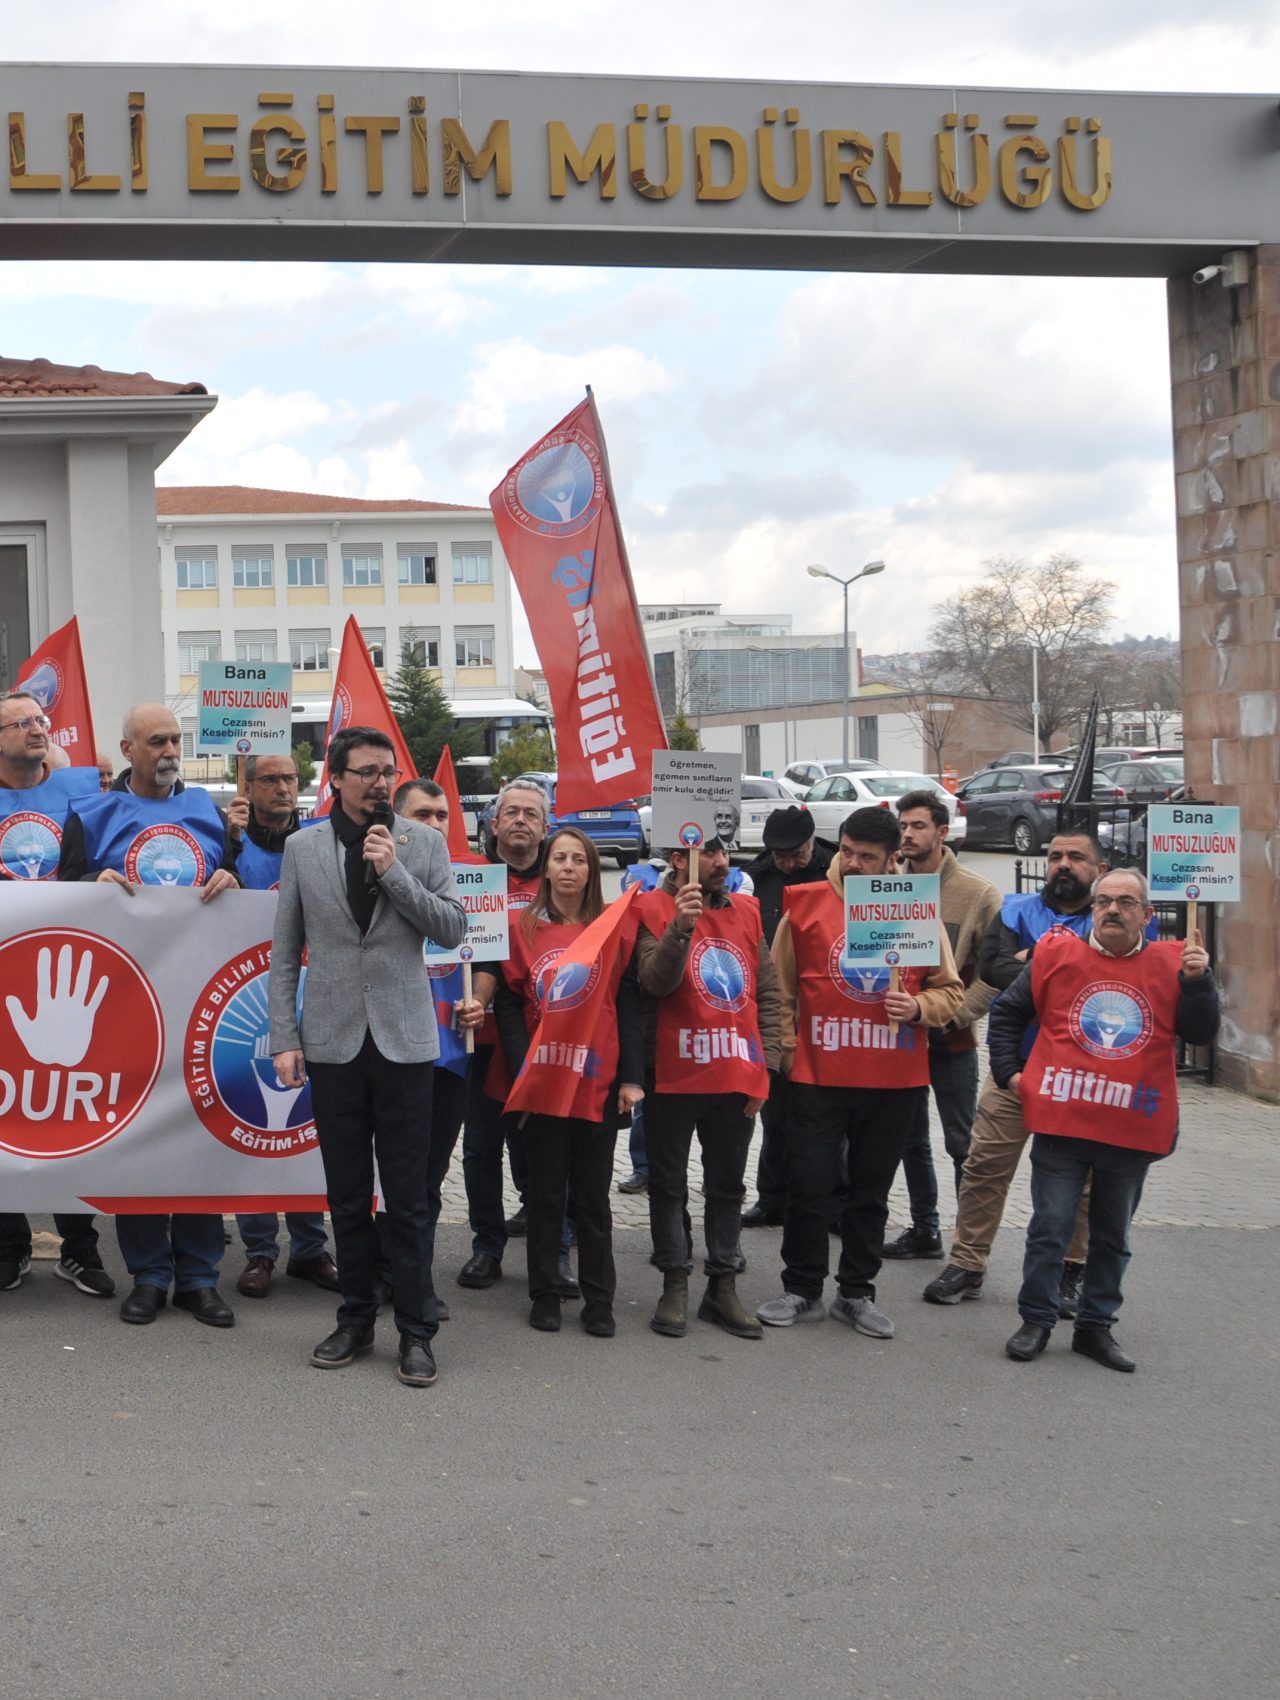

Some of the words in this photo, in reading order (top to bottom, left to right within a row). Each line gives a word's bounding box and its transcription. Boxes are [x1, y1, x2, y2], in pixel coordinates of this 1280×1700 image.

[187, 91, 512, 197] EĞİTİM
[546, 102, 1114, 211] MÜDÜRLÜĞÜ
[225, 665, 266, 680] Bana
[202, 688, 288, 709] MUTSUZLUĞUN
[222, 717, 266, 727] Cezasını
[202, 728, 247, 737] Kesebilir
[250, 730, 286, 738] misin?
[654, 773, 690, 781] egemen
[1173, 809, 1213, 824] Bana
[1152, 832, 1236, 854] MUTSUZLUĞUN
[1171, 863, 1214, 872] Cezasını
[452, 871, 483, 884] ana
[1152, 874, 1196, 883] Kesebilir
[1199, 875, 1234, 884] misin?
[871, 880, 913, 893] Bana
[460, 891, 504, 913] ZLUĞUN
[849, 899, 936, 921] MUTSUZLUĞUN
[472, 934, 503, 944] misin?
[870, 931, 914, 940] Cezasını
[850, 942, 896, 951] Kesebilir
[898, 940, 934, 950] misin?
[209, 959, 256, 1006] BİLİM
[196, 1007, 215, 1033] VE
[192, 1040, 215, 1109] EĞİTİM
[1039, 1065, 1161, 1119] Eğitimiş
[230, 1125, 318, 1152] EĞİTİM-İŞ
